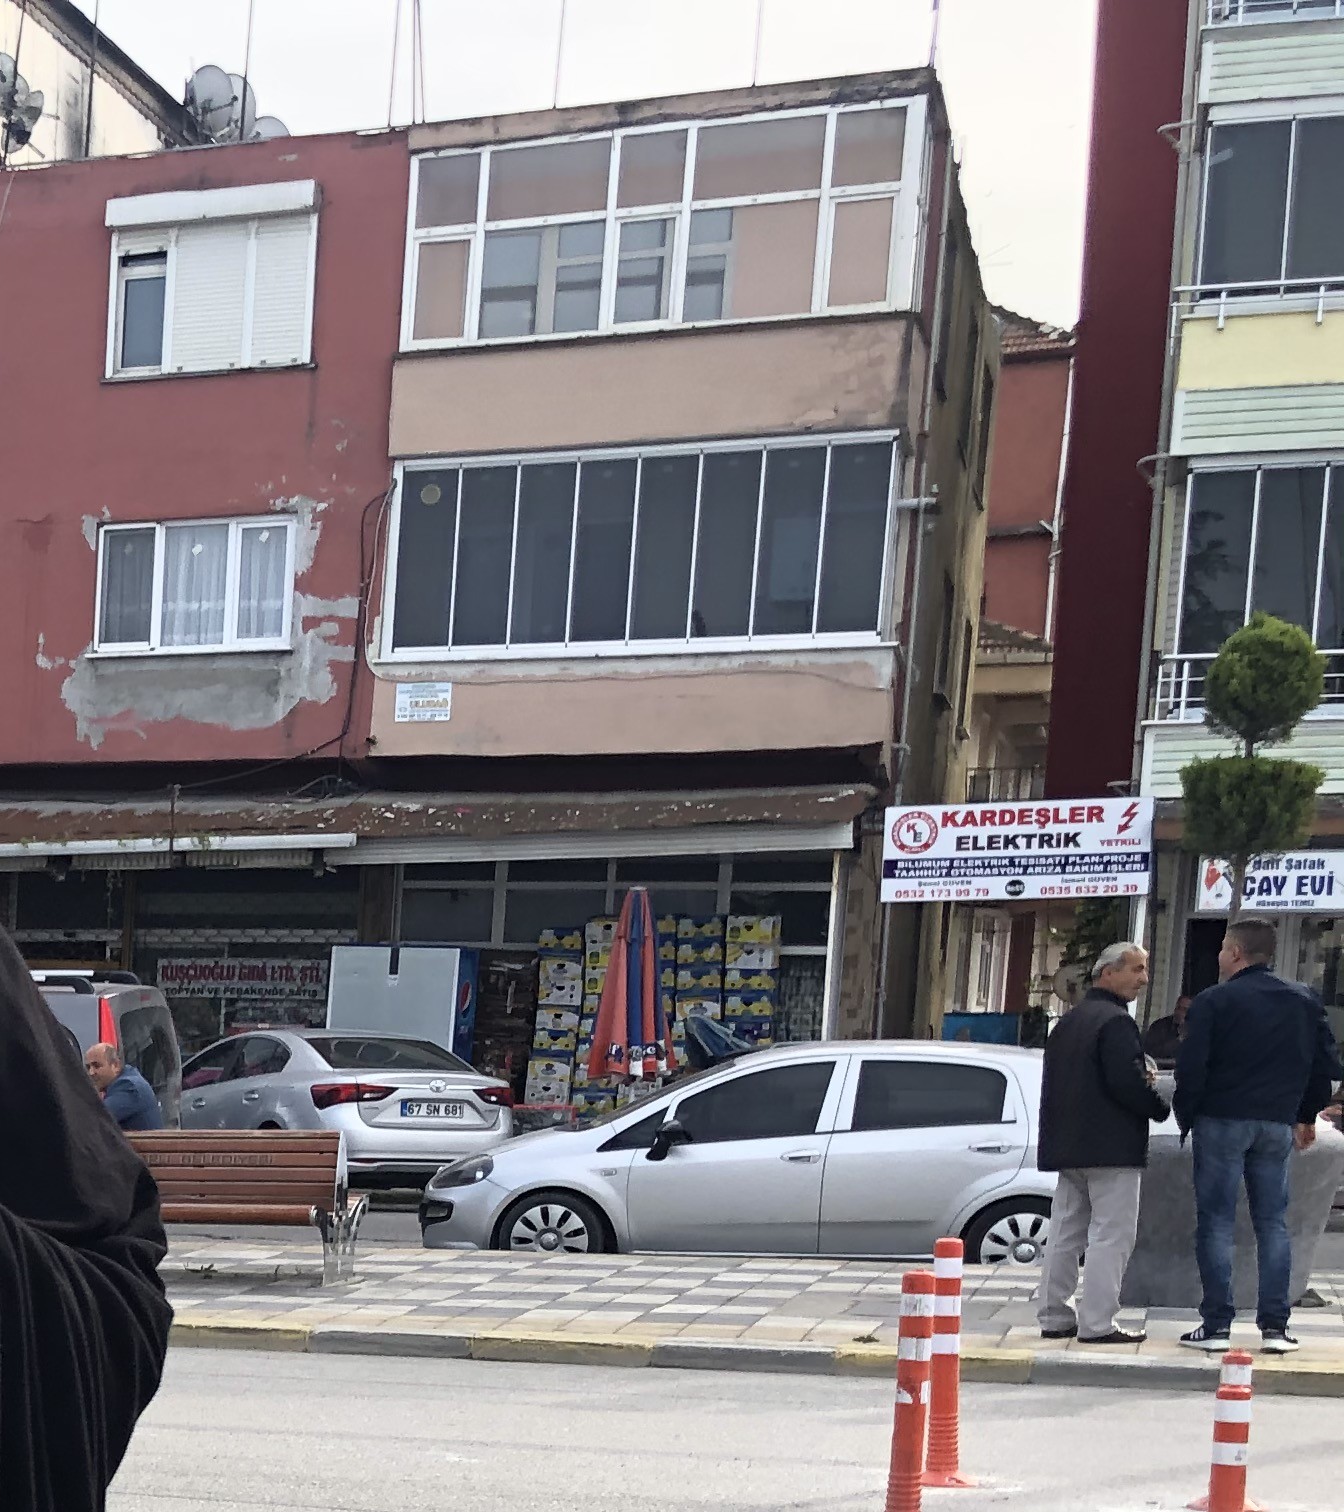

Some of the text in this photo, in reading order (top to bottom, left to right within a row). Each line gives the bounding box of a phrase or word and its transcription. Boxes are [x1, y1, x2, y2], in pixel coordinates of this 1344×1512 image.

[941, 806, 1105, 830] KARDEŞLER
[1242, 870, 1335, 901] ÇAY EVİ
[407, 1103, 462, 1116] 67 SN 681
